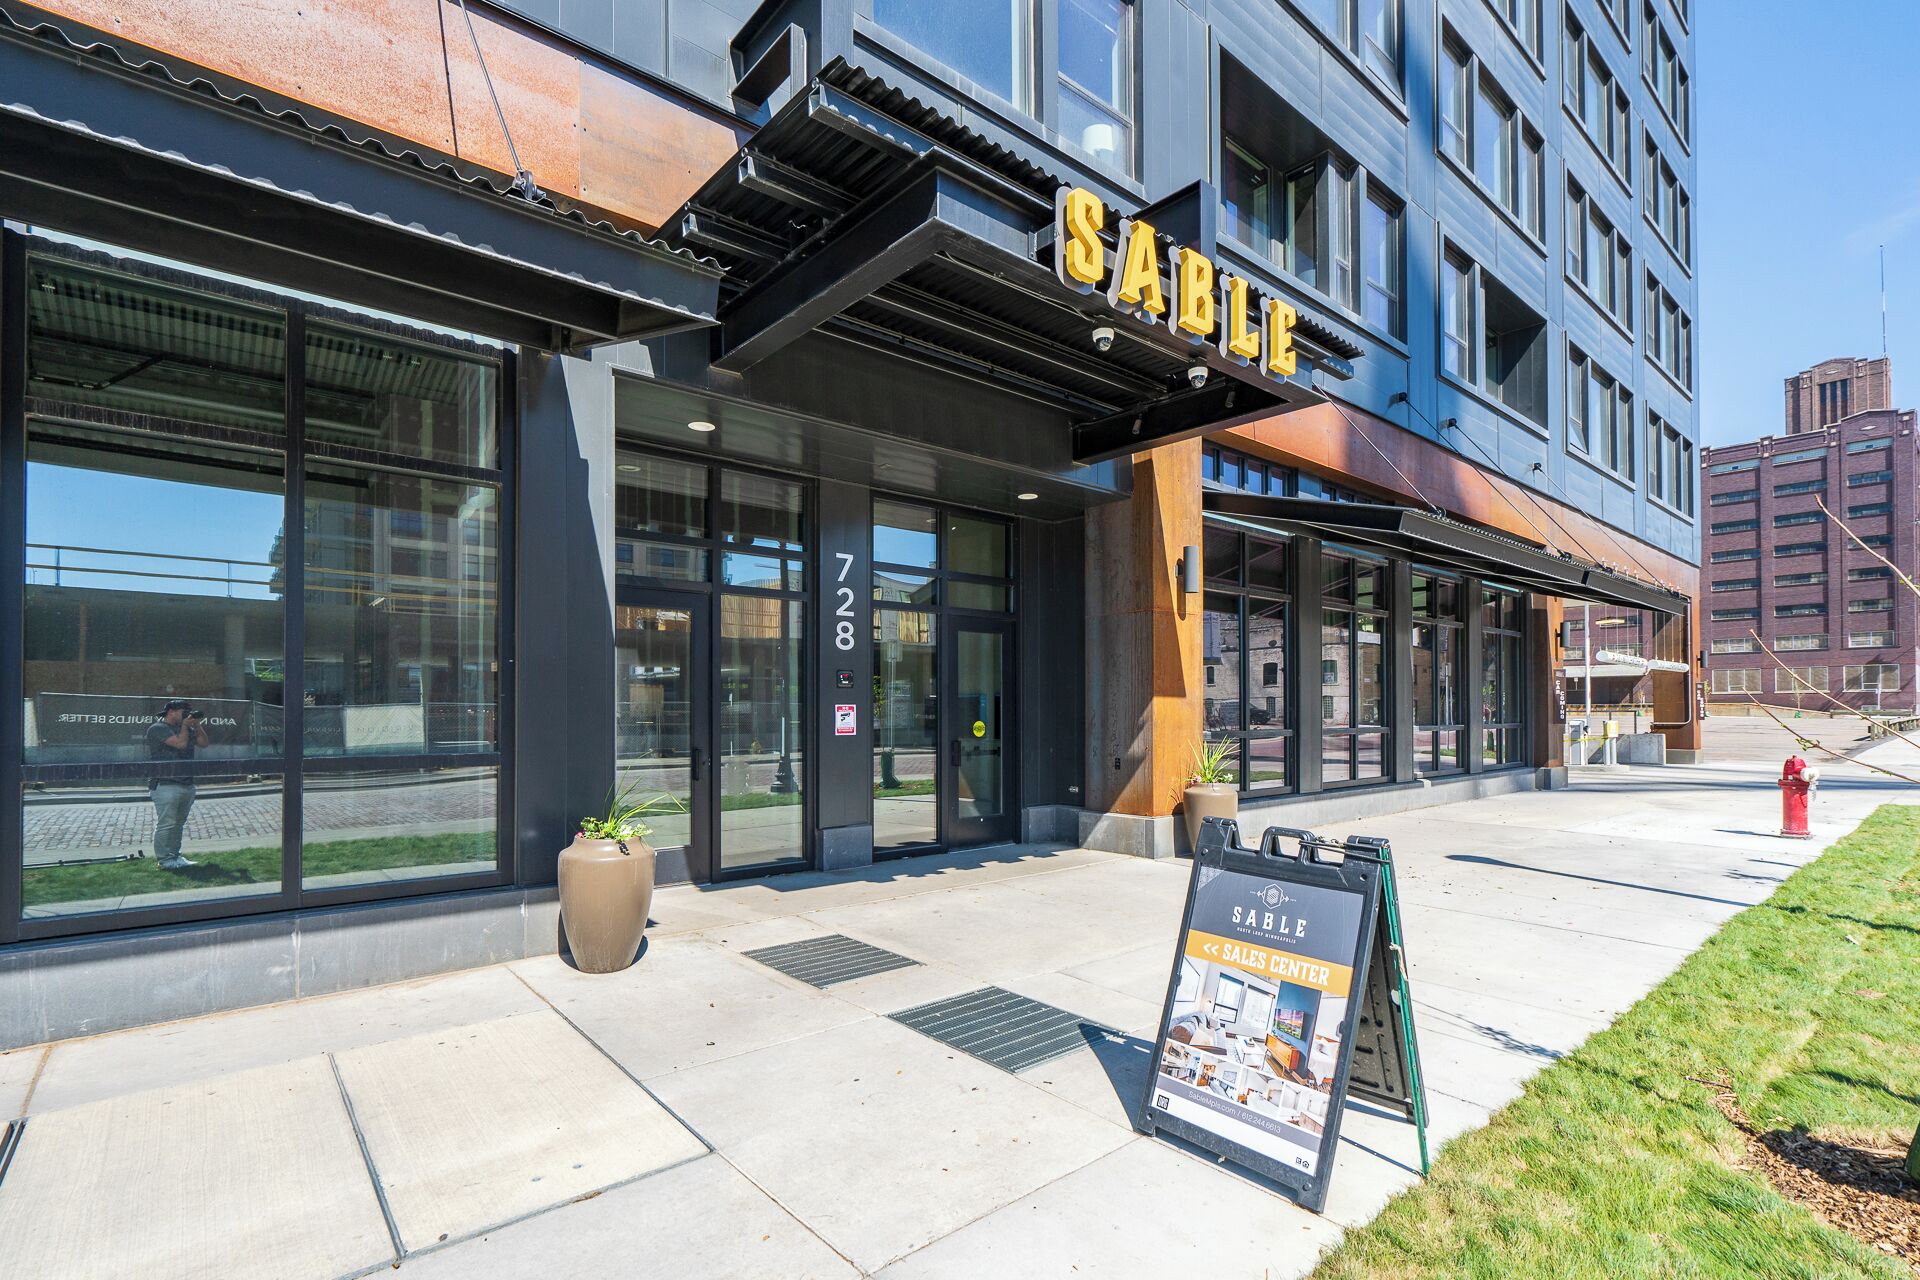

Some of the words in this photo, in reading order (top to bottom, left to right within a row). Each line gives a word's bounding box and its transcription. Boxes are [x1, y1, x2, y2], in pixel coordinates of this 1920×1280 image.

[1060, 187, 1297, 378] SABLE
[835, 552, 855, 651] 728
[1231, 906, 1307, 938] SABLE
[1236, 926, 1251, 934] NORTH
[1252, 929, 1264, 937] LOOP
[1264, 933, 1296, 944] MINNEAPOLIS
[1222, 944, 1267, 969] SALES
[1270, 955, 1330, 986] CENTER
[1188, 1091, 1236, 1115] SableMpls.com
[1241, 1112, 1281, 1134] 612.244.6613
